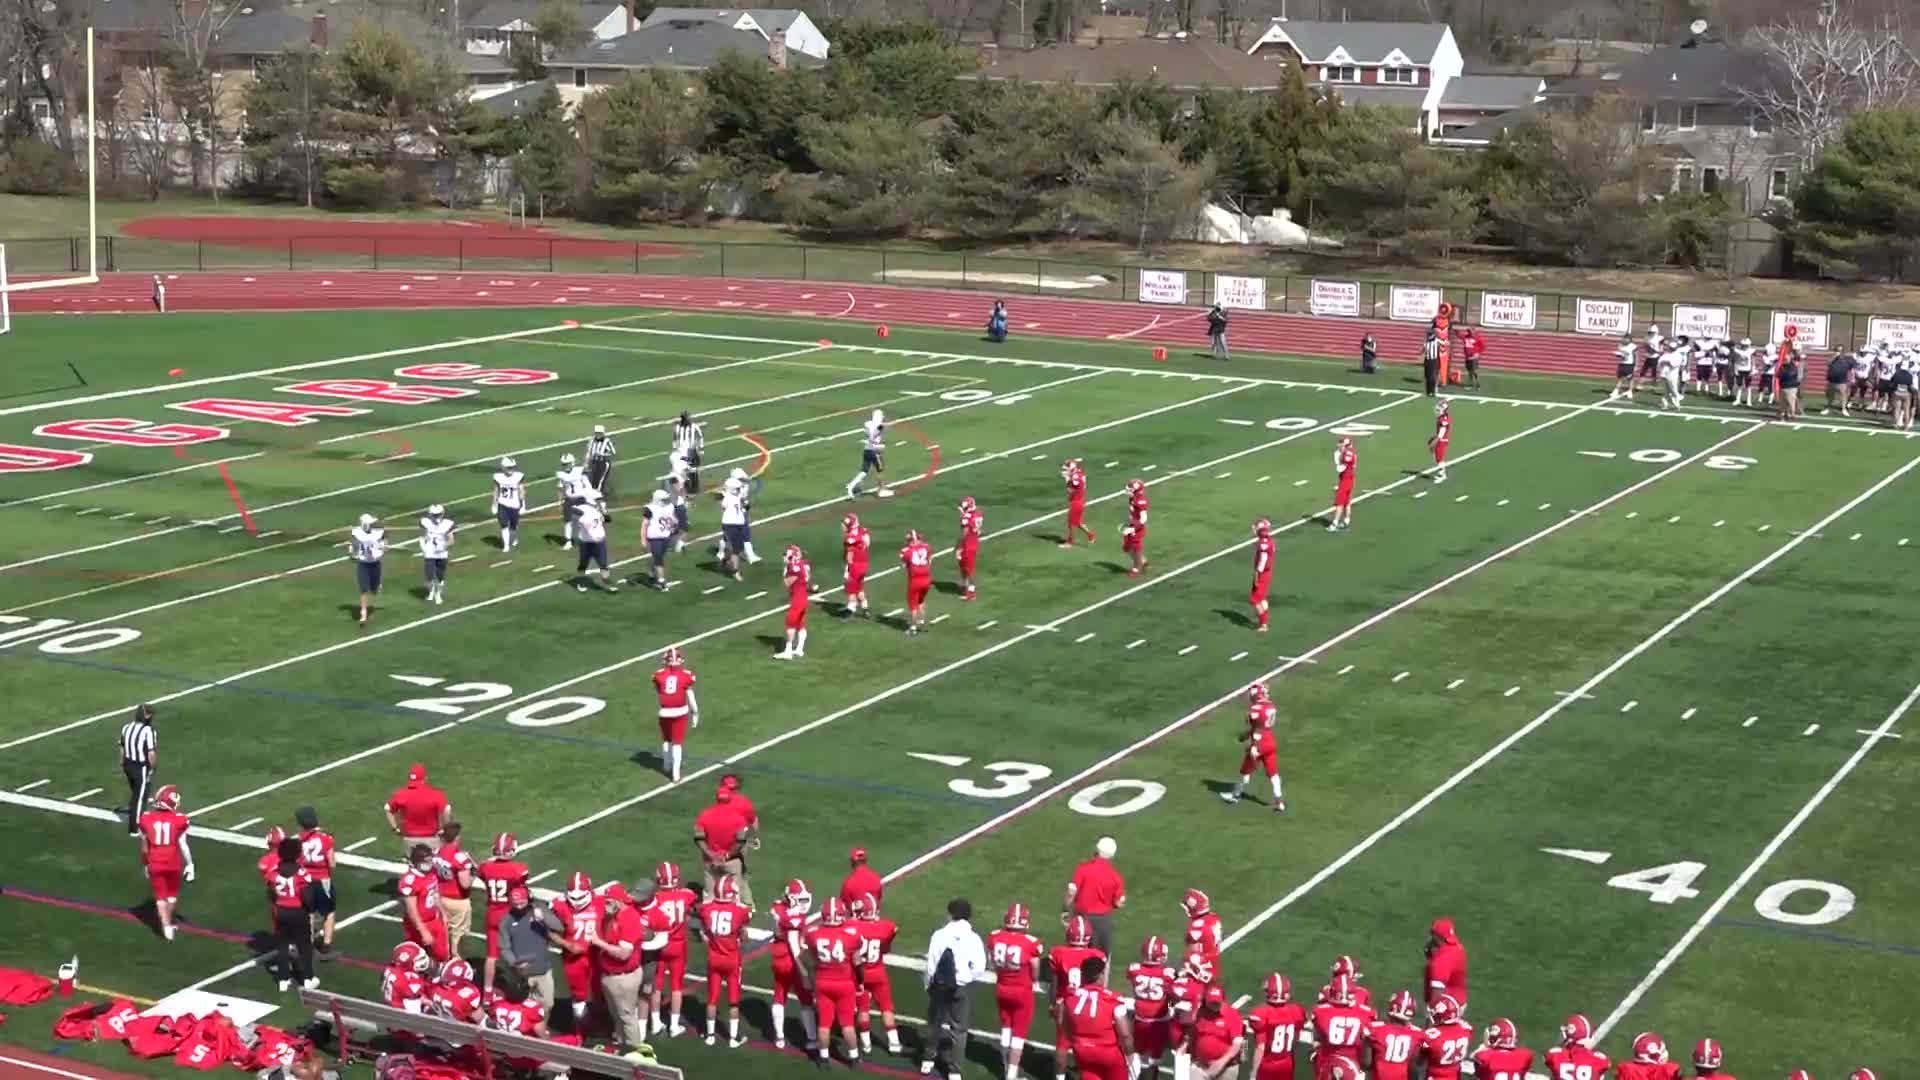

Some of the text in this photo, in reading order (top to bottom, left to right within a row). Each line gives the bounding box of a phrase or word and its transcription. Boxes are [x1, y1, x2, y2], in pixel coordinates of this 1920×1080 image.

[1490, 297, 1526, 309] MATERA
[1492, 310, 1524, 321] FAMILY
[1587, 316, 1619, 328] FAMILY
[912, 547, 929, 566] 42
[395, 682, 612, 727] 20
[947, 761, 1168, 817] 30
[153, 820, 171, 846] 11
[488, 879, 508, 902] 12
[1606, 860, 1857, 926] 40
[710, 909, 733, 937] 16
[816, 937, 846, 963] 54
[1134, 974, 1165, 1001] 25
[1073, 987, 1099, 1018] 71
[1271, 1023, 1295, 1054] 81
[1328, 1015, 1361, 1046] 67
[1384, 1033, 1411, 1063] 10
